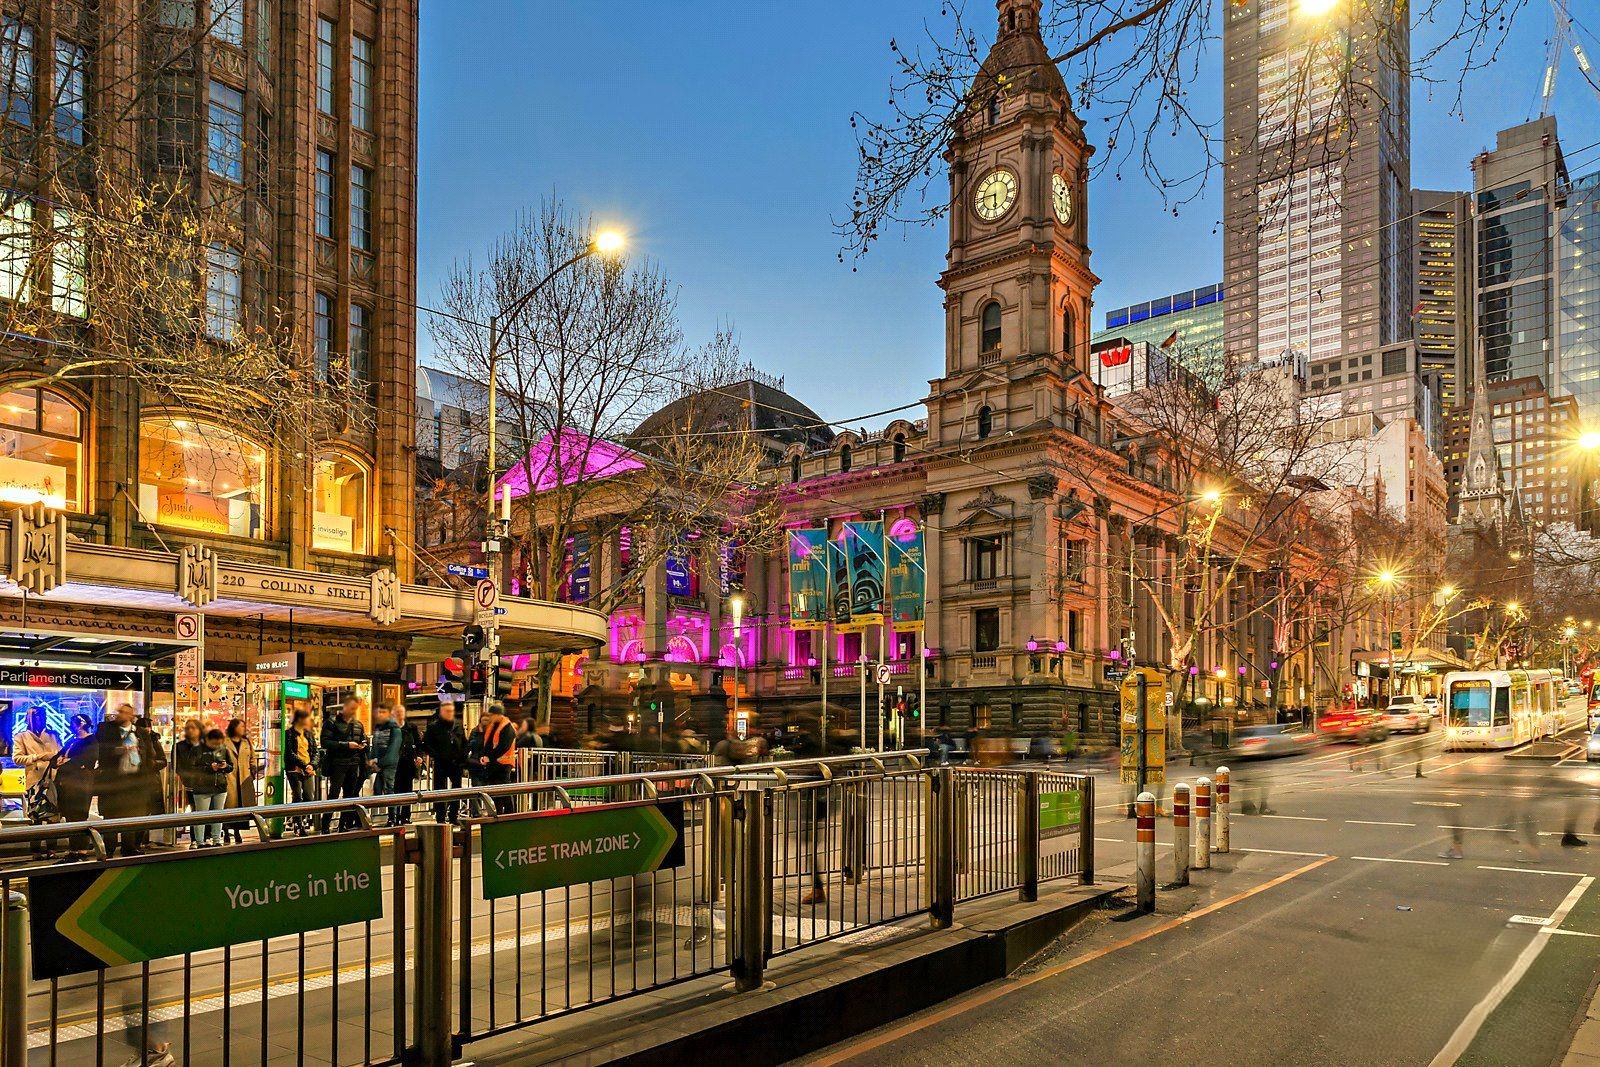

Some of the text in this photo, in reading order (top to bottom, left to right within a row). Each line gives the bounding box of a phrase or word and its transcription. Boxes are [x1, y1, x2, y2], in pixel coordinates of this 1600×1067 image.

[317, 524, 348, 537] invisalign
[222, 575, 366, 600] 220 COLLINS STREET
[0, 670, 112, 686] Parliament Station
[508, 834, 630, 867] FREE TRAM ZONE
[224, 869, 370, 909] You're in the
